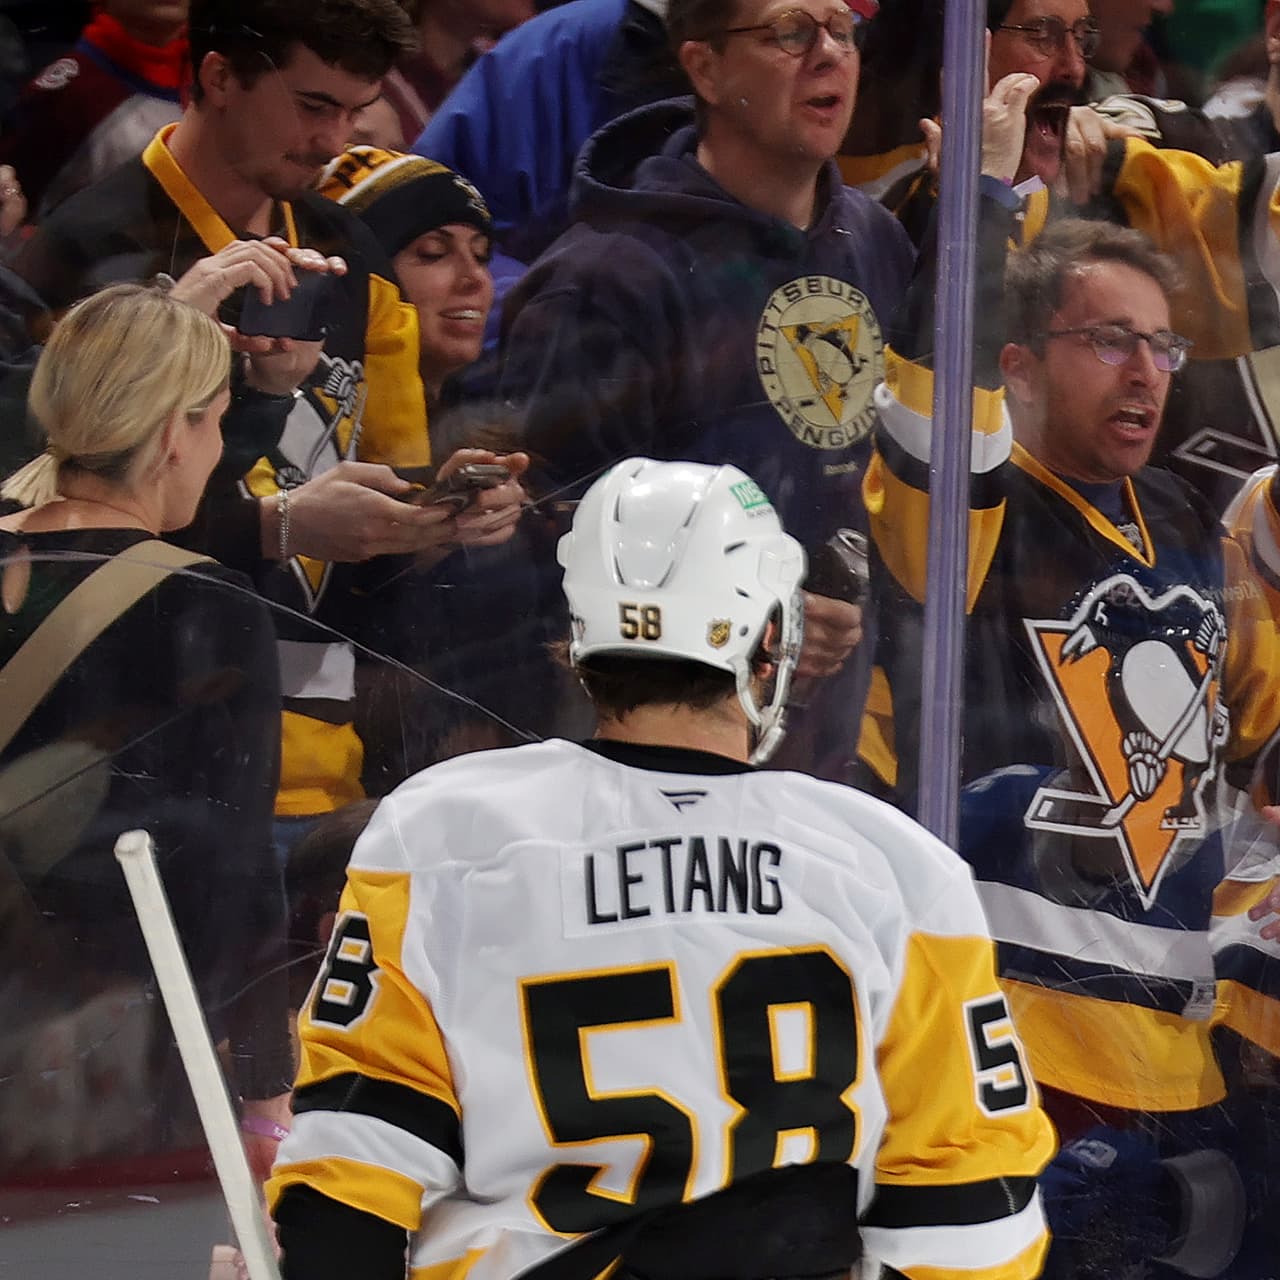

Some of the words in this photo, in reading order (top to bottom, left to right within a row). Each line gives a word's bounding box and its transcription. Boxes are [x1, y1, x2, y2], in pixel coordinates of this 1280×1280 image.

[618, 602, 662, 641] 58
[584, 835, 783, 925] LETANG
[515, 942, 864, 1238] 58
[962, 990, 1031, 1118] 5
